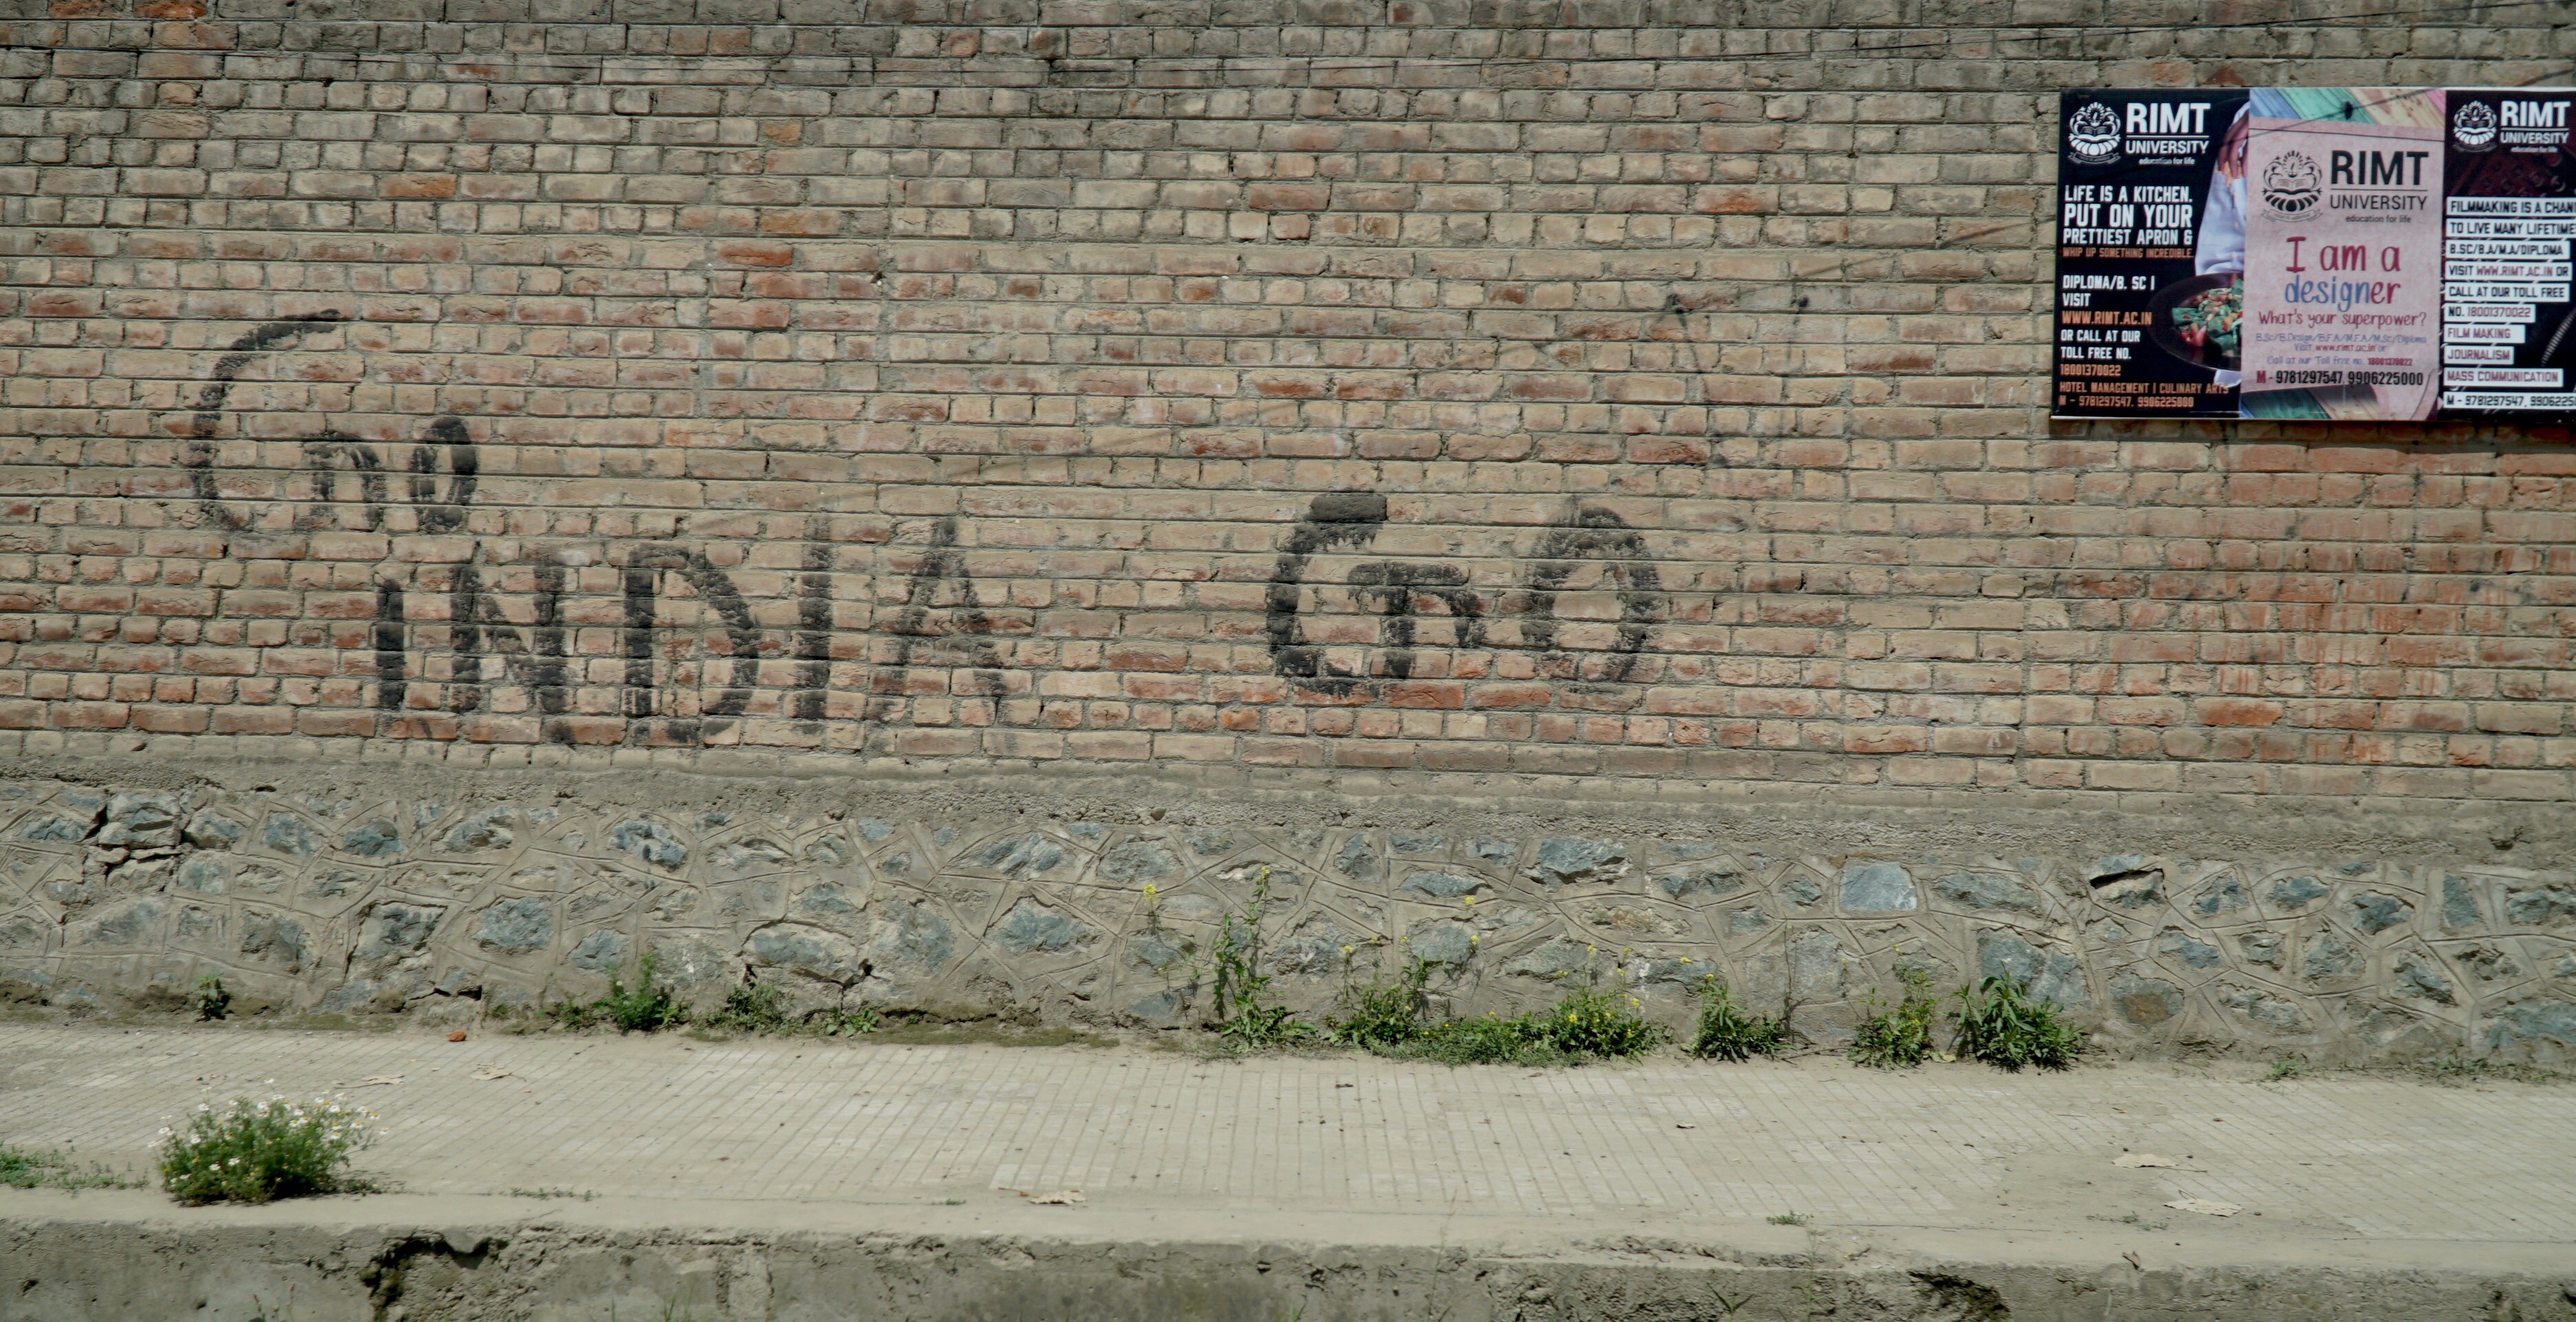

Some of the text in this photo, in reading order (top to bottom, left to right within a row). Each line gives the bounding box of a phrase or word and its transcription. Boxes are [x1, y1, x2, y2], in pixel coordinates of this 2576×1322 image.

[2126, 103, 2211, 134] RIMT
[2501, 100, 2571, 127] RIMT
[2500, 131, 2570, 144] UNIVERSITY
[2126, 140, 2209, 154] UNIVERSITY
[2139, 157, 2172, 165] education
[2331, 150, 2429, 185] RIMT
[2065, 185, 2193, 203] LIFE IS A KITCHEN.
[2330, 194, 2428, 210] UNIVERSITY
[2451, 200, 2576, 213] FILMMAKING IS A CHAN
[2064, 203, 2193, 228] PUT ON YOUR
[2345, 215, 2384, 223] education
[2386, 215, 2397, 223] for
[2450, 222, 2463, 234] TO
[2467, 222, 2491, 234] LIVE
[2494, 222, 2522, 235] MANY
[2062, 228, 2193, 245] PRETTIEST APRON &
[2062, 247, 2194, 259] WHIP UP SOMETHING INCREDIBLE.
[2286, 236, 2401, 273] I am a
[2449, 266, 2568, 276] VISIT WWW.RIMT.AC.IN OR
[2062, 275, 2127, 290] DIPLOMA/B.
[2131, 276, 2146, 290] SC
[2285, 275, 2401, 312] designer
[2449, 286, 2565, 297] CALL AT OUR TOLL FREE
[2062, 292, 2091, 307] VISIT
[2448, 306, 2531, 317] NO. 18001370022
[2061, 311, 2153, 326] WWW.RIMT.AC.IN
[2259, 308, 2427, 329] What's your superpower?
[2060, 330, 2141, 342] OR CALL AT OUR
[2447, 328, 2511, 339] FILM MAKING
[2060, 346, 2131, 359] TOLL FREE NO.
[2447, 350, 2510, 360] JOURNALISM
[2267, 356, 2283, 365] Call
[2315, 356, 2330, 365] Toll
[2333, 356, 2350, 365] free
[2060, 364, 2122, 376] 18001370022
[2447, 371, 2558, 382] MASS COMMUNICATION
[2257, 370, 2266, 383] M
[2348, 371, 2423, 385] 9906225000
[2059, 382, 2087, 393] HOTEL
[2091, 382, 2149, 394] MANAGEMENT
[2159, 383, 2202, 394] CULINARY
[2206, 383, 2229, 394] ARTS
[2059, 396, 2067, 406] M
[2137, 396, 2194, 407] 9906225000
[2447, 395, 2454, 404] M
[376, 515, 1017, 747] INDIA
